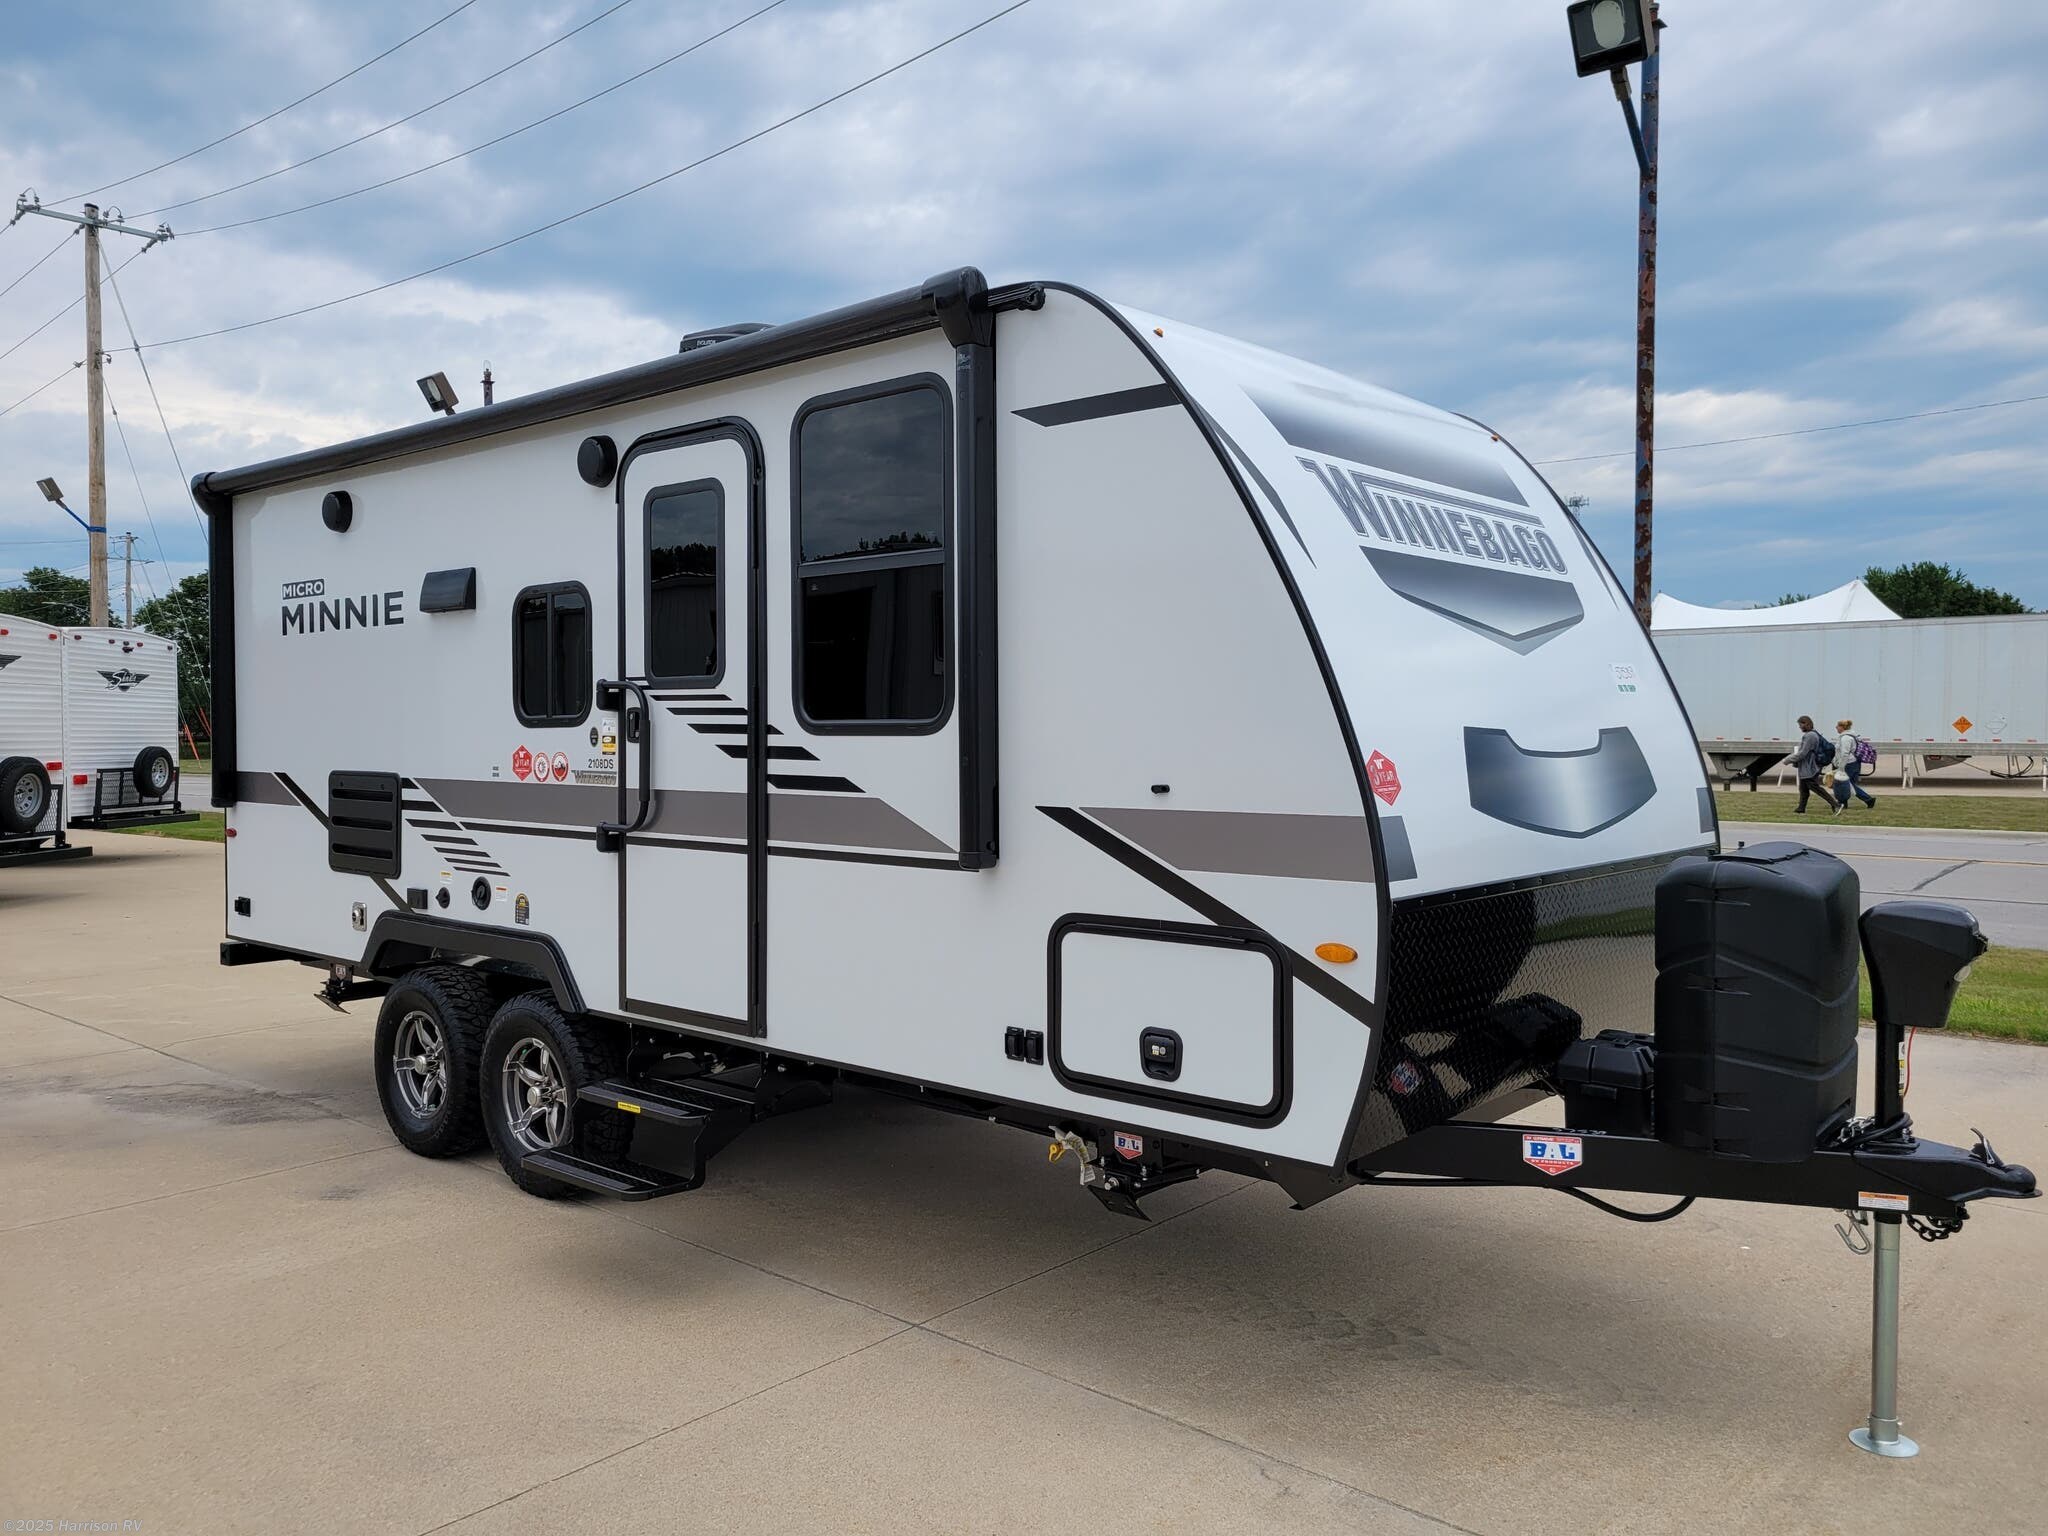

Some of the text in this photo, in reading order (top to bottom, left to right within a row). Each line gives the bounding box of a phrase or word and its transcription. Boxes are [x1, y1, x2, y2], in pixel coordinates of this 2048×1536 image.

[1295, 455, 1568, 575] WINNEBAGO
[282, 580, 324, 599] MICRO
[281, 591, 404, 636] MINNIE
